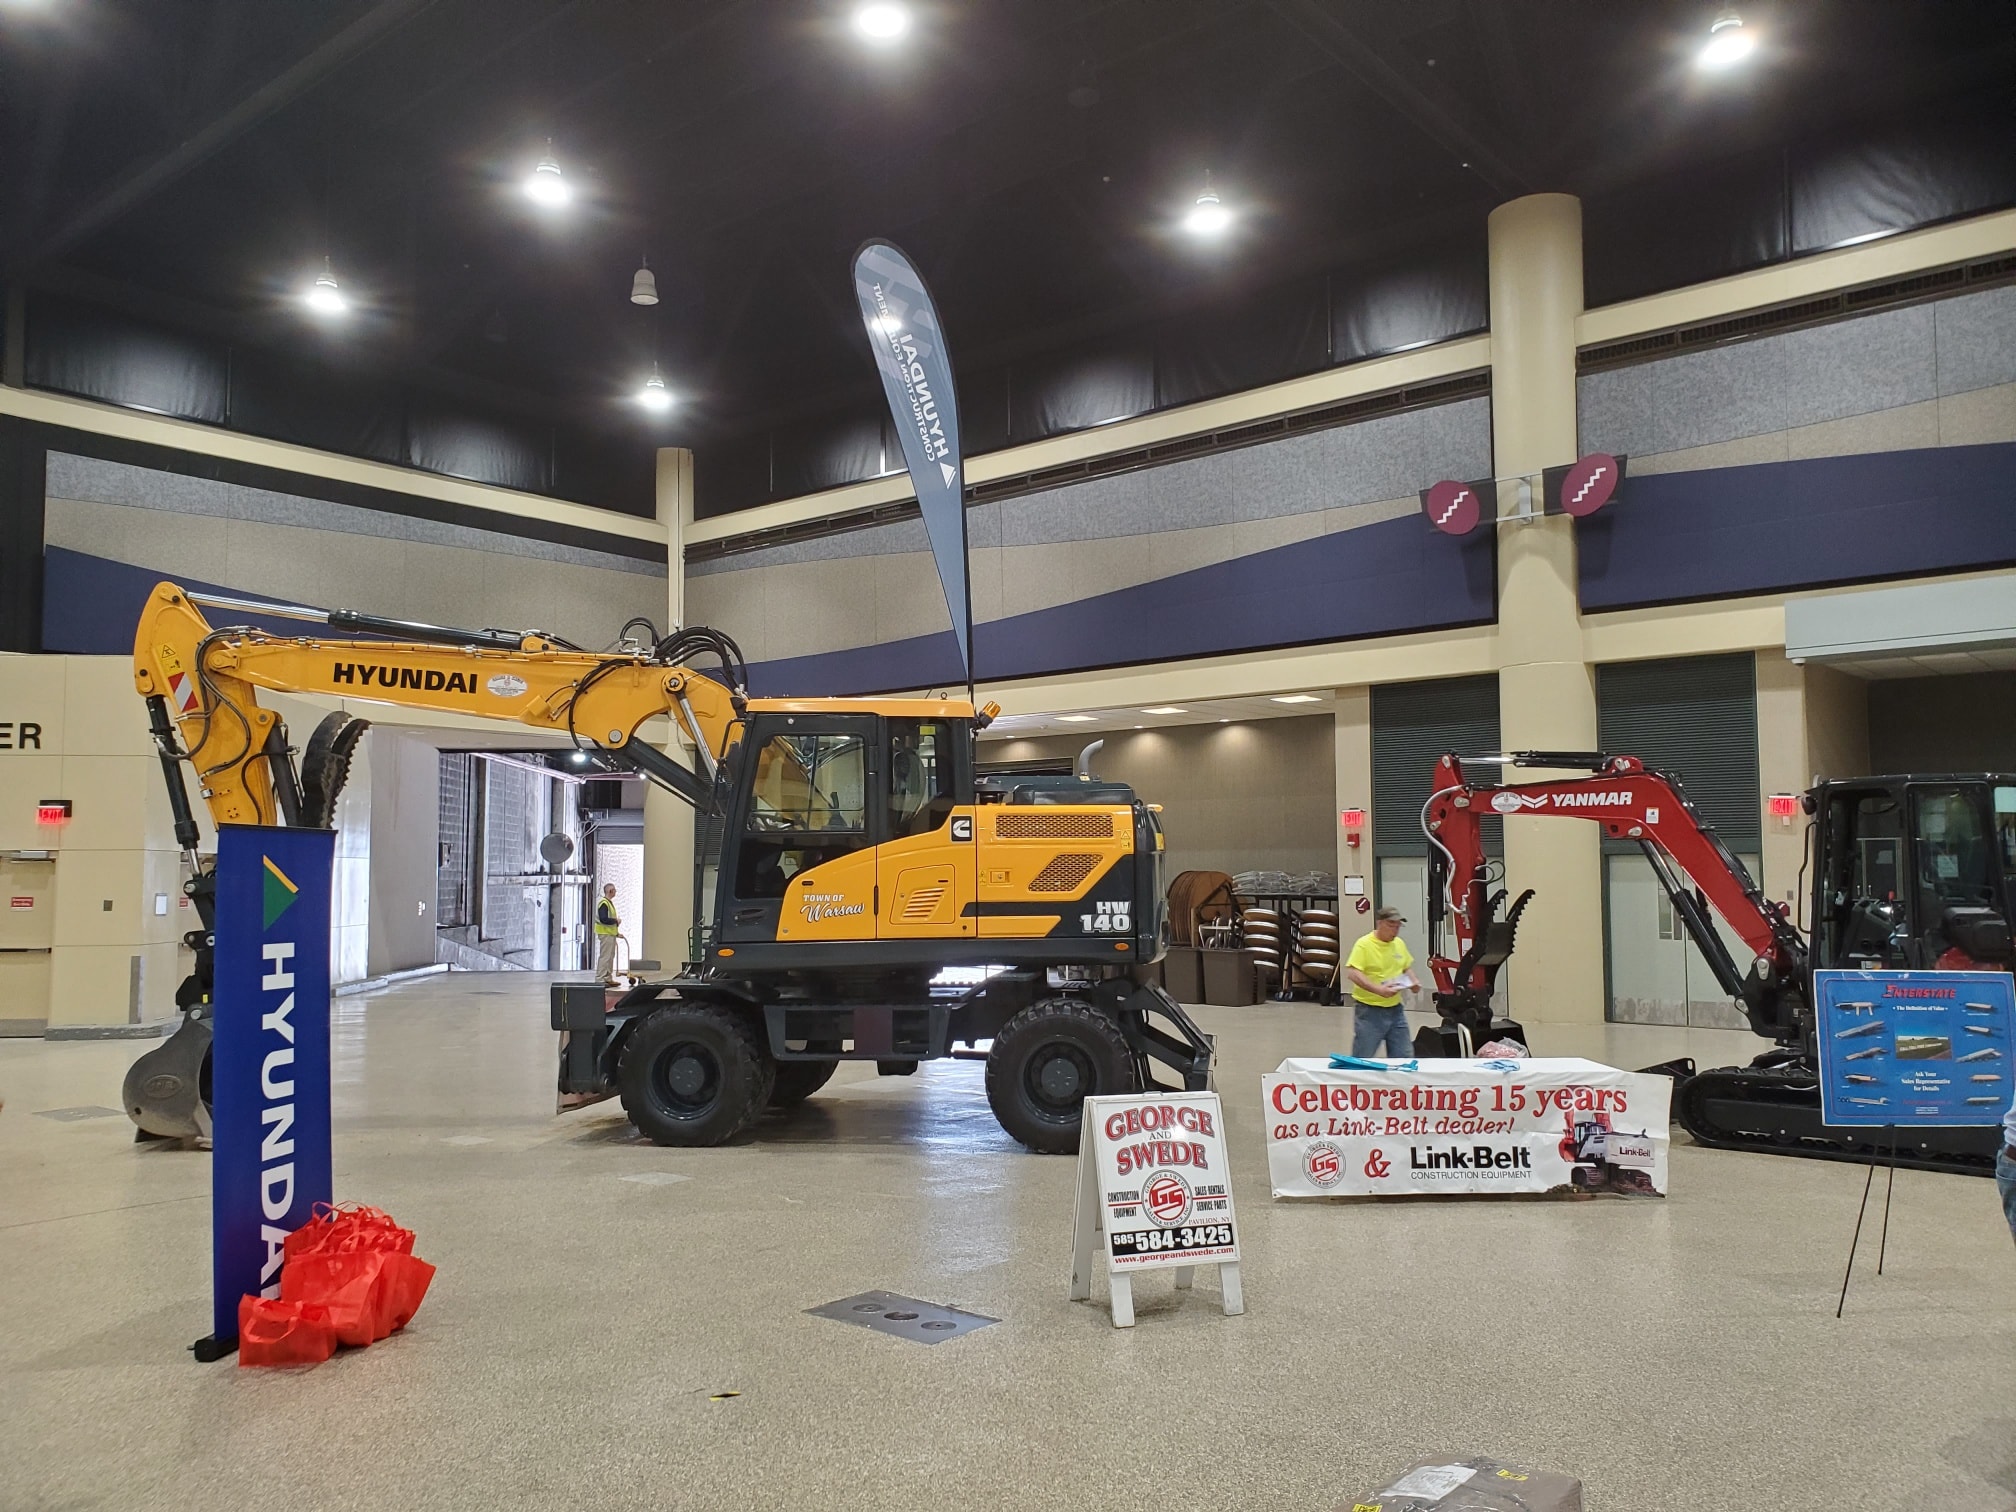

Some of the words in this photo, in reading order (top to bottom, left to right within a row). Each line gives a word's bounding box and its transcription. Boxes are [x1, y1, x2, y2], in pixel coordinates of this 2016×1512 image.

[333, 662, 478, 694] HYUNDAI
[1552, 792, 1633, 807] YANMAR
[1773, 799, 1793, 813] EXIT
[41, 809, 62, 823] EXIT
[803, 894, 830, 902] TOWN
[832, 894, 845, 902] OF
[800, 902, 865, 923] Warsaw
[1096, 901, 1131, 914] HW
[1079, 914, 1131, 932] 140
[1882, 985, 1957, 999] INTERSTATE
[1272, 1083, 1480, 1118] Celebrating
[1490, 1085, 1526, 1111] 15
[1532, 1085, 1627, 1117] years
[1105, 1104, 1215, 1141] GEORGE
[1274, 1122, 1299, 1139] as
[1305, 1121, 1320, 1137] a
[1327, 1115, 1429, 1136] Link-Belt
[1435, 1115, 1515, 1135] dealer!
[1149, 1130, 1172, 1140] AND
[1117, 1141, 1209, 1176] SWEDE
[1410, 1145, 1530, 1169] Link-Belt
[1619, 1146, 1651, 1157] Link-Belt
[1364, 1149, 1391, 1178] &
[1411, 1171, 1479, 1179] CONSTRUCTION
[1481, 1170, 1531, 1179] EQUIPMENT
[1107, 1190, 1140, 1203] CONSTRUCTION
[1194, 1186, 1207, 1196] SALES
[1207, 1184, 1225, 1195] RENTALS
[1196, 1201, 1213, 1211] SERVICE
[1214, 1199, 1227, 1210] PARTS
[1113, 1206, 1137, 1219] EQUIPMENT
[1188, 1217, 1220, 1225] PAVILION,
[1113, 1233, 1134, 1245] 585
[1135, 1224, 1232, 1251] 584-3425
[1114, 1247, 1234, 1263] www.georgeandswede.com
